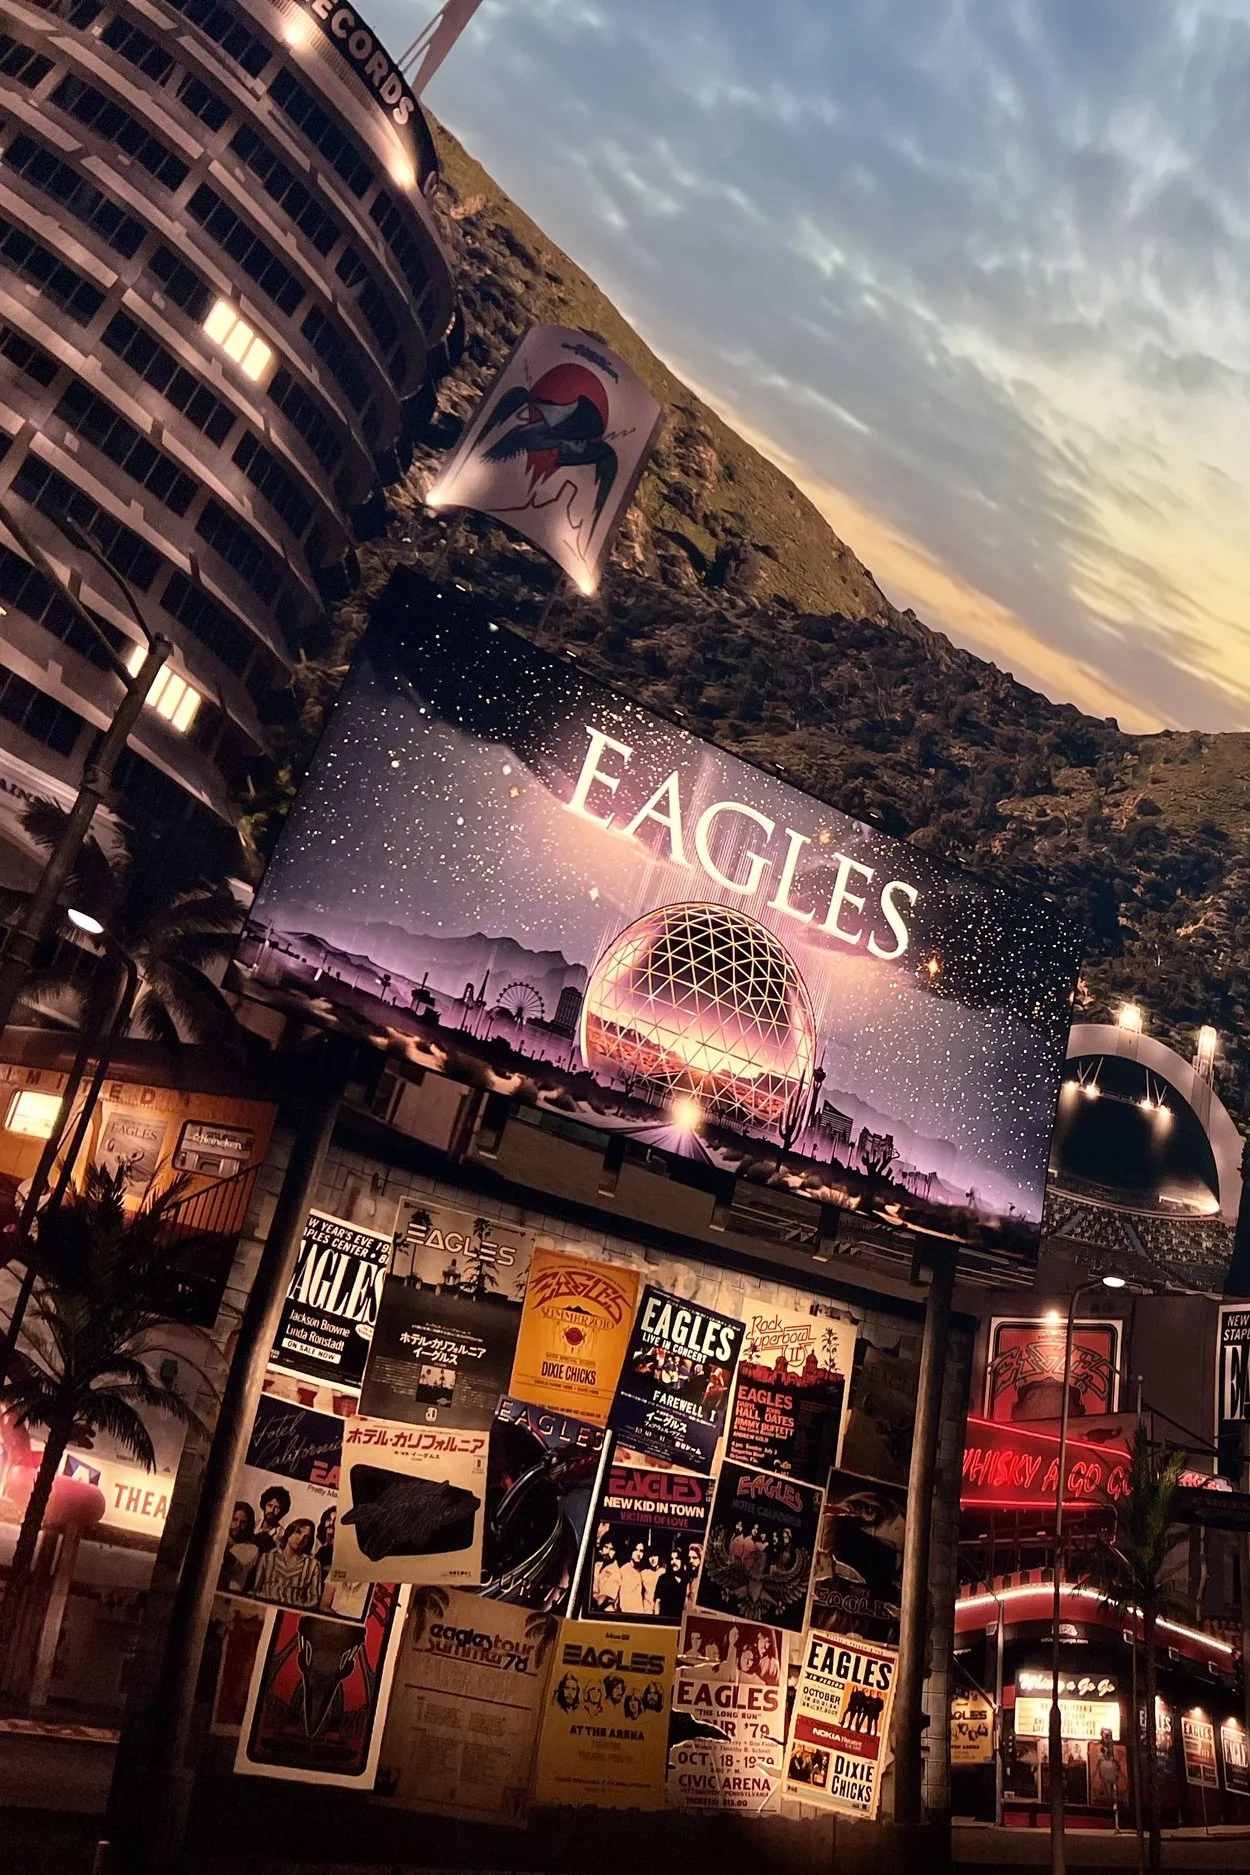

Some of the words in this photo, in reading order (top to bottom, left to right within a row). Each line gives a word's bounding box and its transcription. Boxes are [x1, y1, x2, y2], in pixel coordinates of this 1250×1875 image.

[561, 725, 919, 961] EAGLES
[110, 1122, 159, 1142] EAGLES
[199, 1132, 243, 1151] Heineken
[321, 1221, 354, 1241] YEAR'S
[354, 1234, 375, 1249] EVE
[405, 1221, 517, 1267] EAGLES
[331, 1238, 369, 1259] CENTER
[530, 1269, 634, 1326] EAGLES
[288, 1308, 320, 1329] Jackson
[319, 1318, 351, 1338] Browne
[640, 1296, 736, 1363] EAGLES
[751, 1314, 784, 1336] Rock
[1226, 1314, 1250, 1327] NEW
[285, 1323, 309, 1341] Linda
[308, 1330, 345, 1352] Ronstadt
[399, 1331, 487, 1359] ホテル・カリフォルニア
[642, 1331, 662, 1347] LIVE
[661, 1338, 672, 1351] IN
[672, 1343, 708, 1365] CONCERT
[745, 1324, 818, 1350] Superbowl
[287, 1340, 297, 1348] ON
[298, 1344, 316, 1355] SALE
[316, 1351, 336, 1361] NOW
[412, 1346, 459, 1366] イーグルス
[541, 1361, 565, 1380] DIXIE
[565, 1364, 597, 1386] CHICKS
[652, 1389, 704, 1419] FAREWELL
[709, 1409, 717, 1423] I
[737, 1384, 794, 1410] EAGLES
[645, 1411, 688, 1434] イーグルス
[734, 1416, 760, 1430] JIMMY
[760, 1422, 795, 1438] BUFFETT
[735, 1406, 761, 1421] HALL
[764, 1412, 795, 1428] OATES
[345, 1427, 485, 1455] ホテル・カリフォルニア
[306, 1484, 327, 1497] Pretty
[608, 1466, 703, 1504] EAGLES
[1067, 1460, 1103, 1497] GO
[114, 1482, 168, 1521] THEA
[736, 1474, 804, 1513] EAGLES
[603, 1496, 632, 1510] NEW
[633, 1499, 655, 1513] KID
[656, 1502, 669, 1514] IN
[670, 1503, 706, 1518] TOWN
[653, 1513, 666, 1525] OF
[666, 1514, 690, 1528] LOVE
[429, 1623, 493, 1653] eagles
[493, 1634, 536, 1656] tour
[562, 1643, 666, 1676] EAGLES
[807, 1640, 893, 1691] EAGLES
[676, 1680, 779, 1712] EAGLES
[803, 1686, 841, 1706] OCTOBER
[716, 1709, 738, 1719] LONG
[569, 1724, 584, 1735] AT
[584, 1726, 606, 1737] THE
[608, 1728, 645, 1741] ARENA
[812, 1727, 841, 1742] NOKIA
[677, 1751, 714, 1767] OCT.
[720, 1754, 734, 1768] 18
[834, 1754, 875, 1784] DIXIE
[678, 1773, 717, 1789] CIVIC
[722, 1776, 772, 1792] ARENA
[831, 1774, 873, 1804] CHICKS
